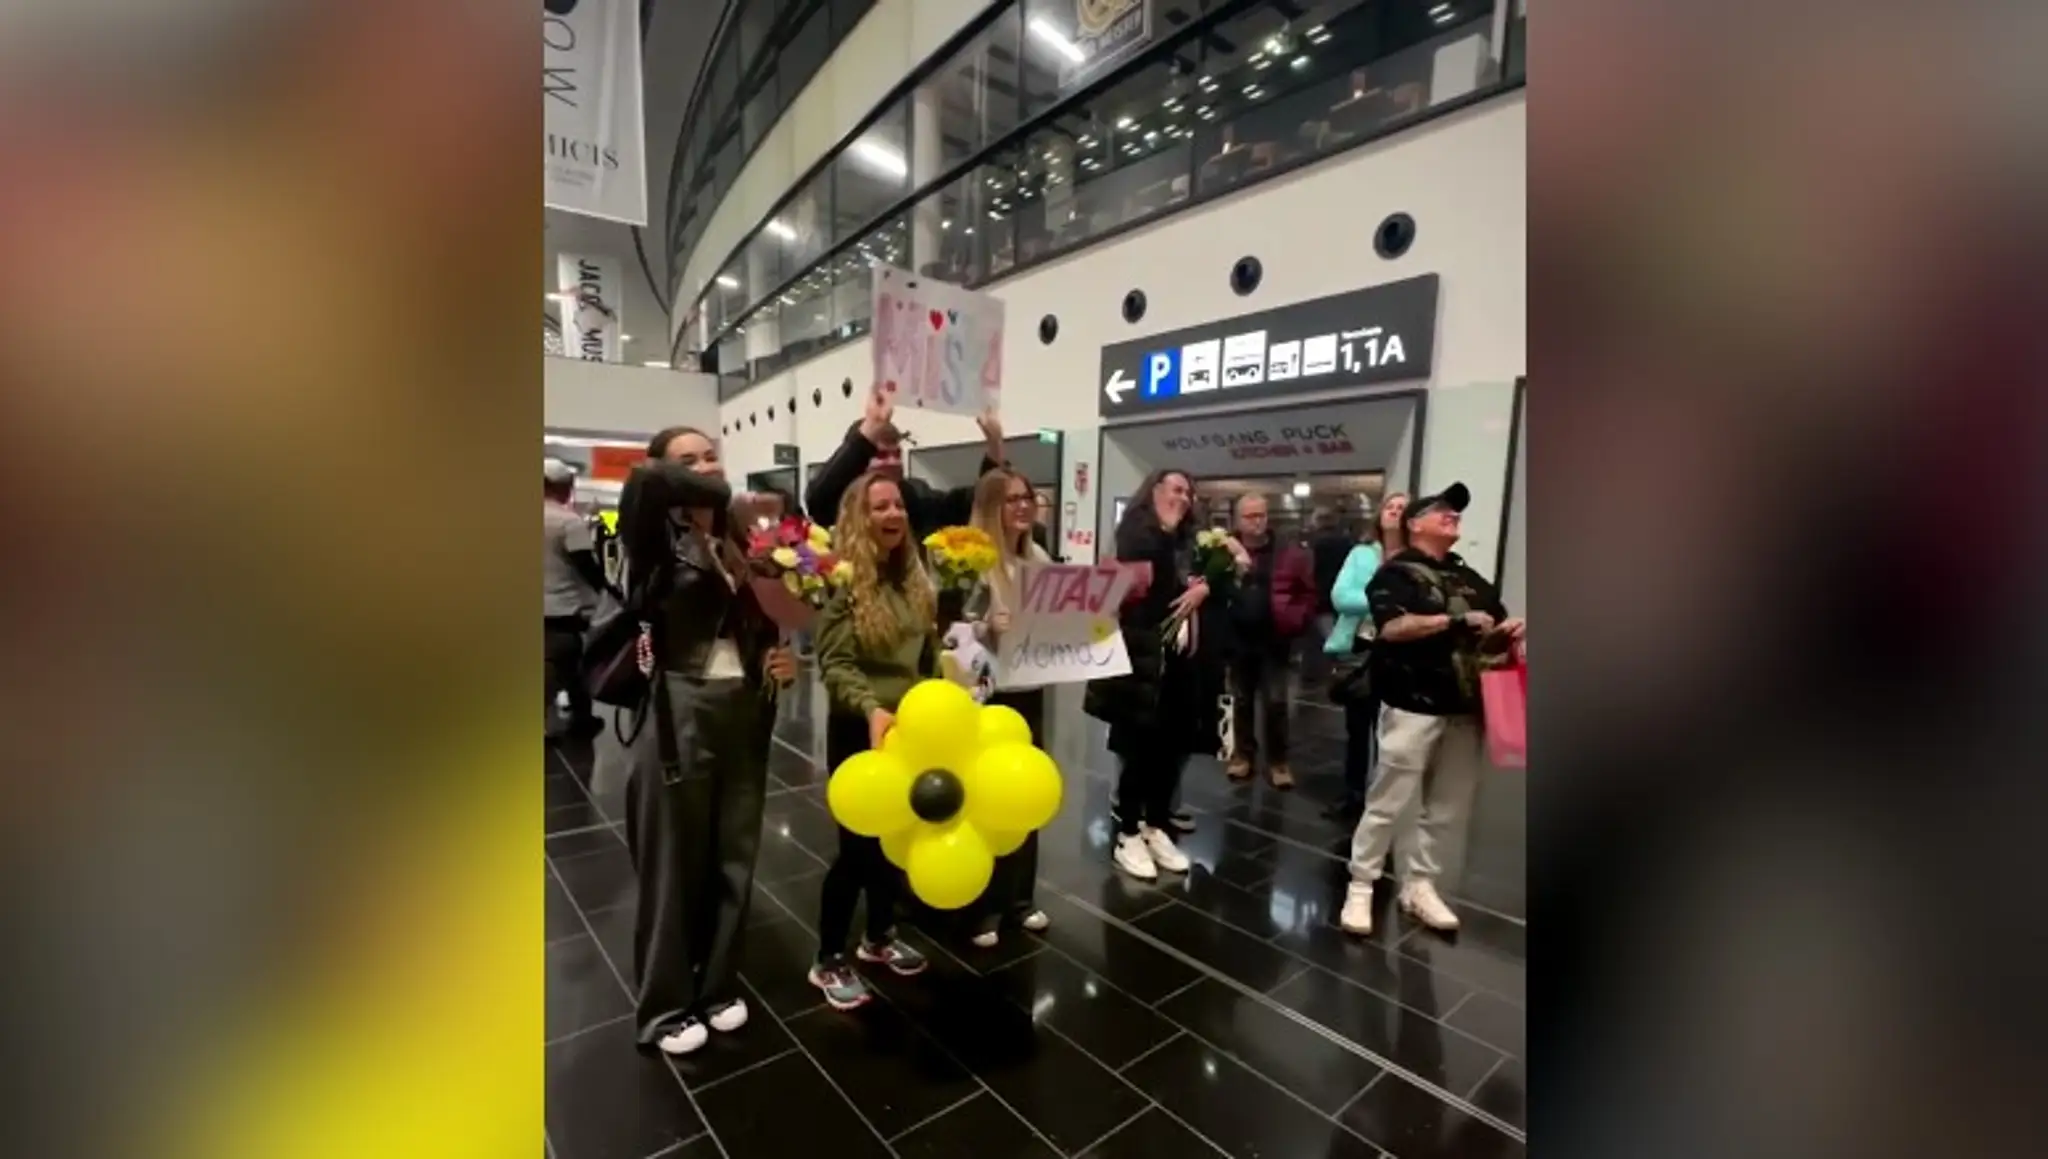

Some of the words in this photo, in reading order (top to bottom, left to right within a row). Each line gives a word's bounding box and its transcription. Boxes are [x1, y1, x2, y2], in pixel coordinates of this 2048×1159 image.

[1150, 353, 1171, 394] P
[1281, 422, 1348, 443] PUCK
[1020, 566, 1118, 614] VITAJ
